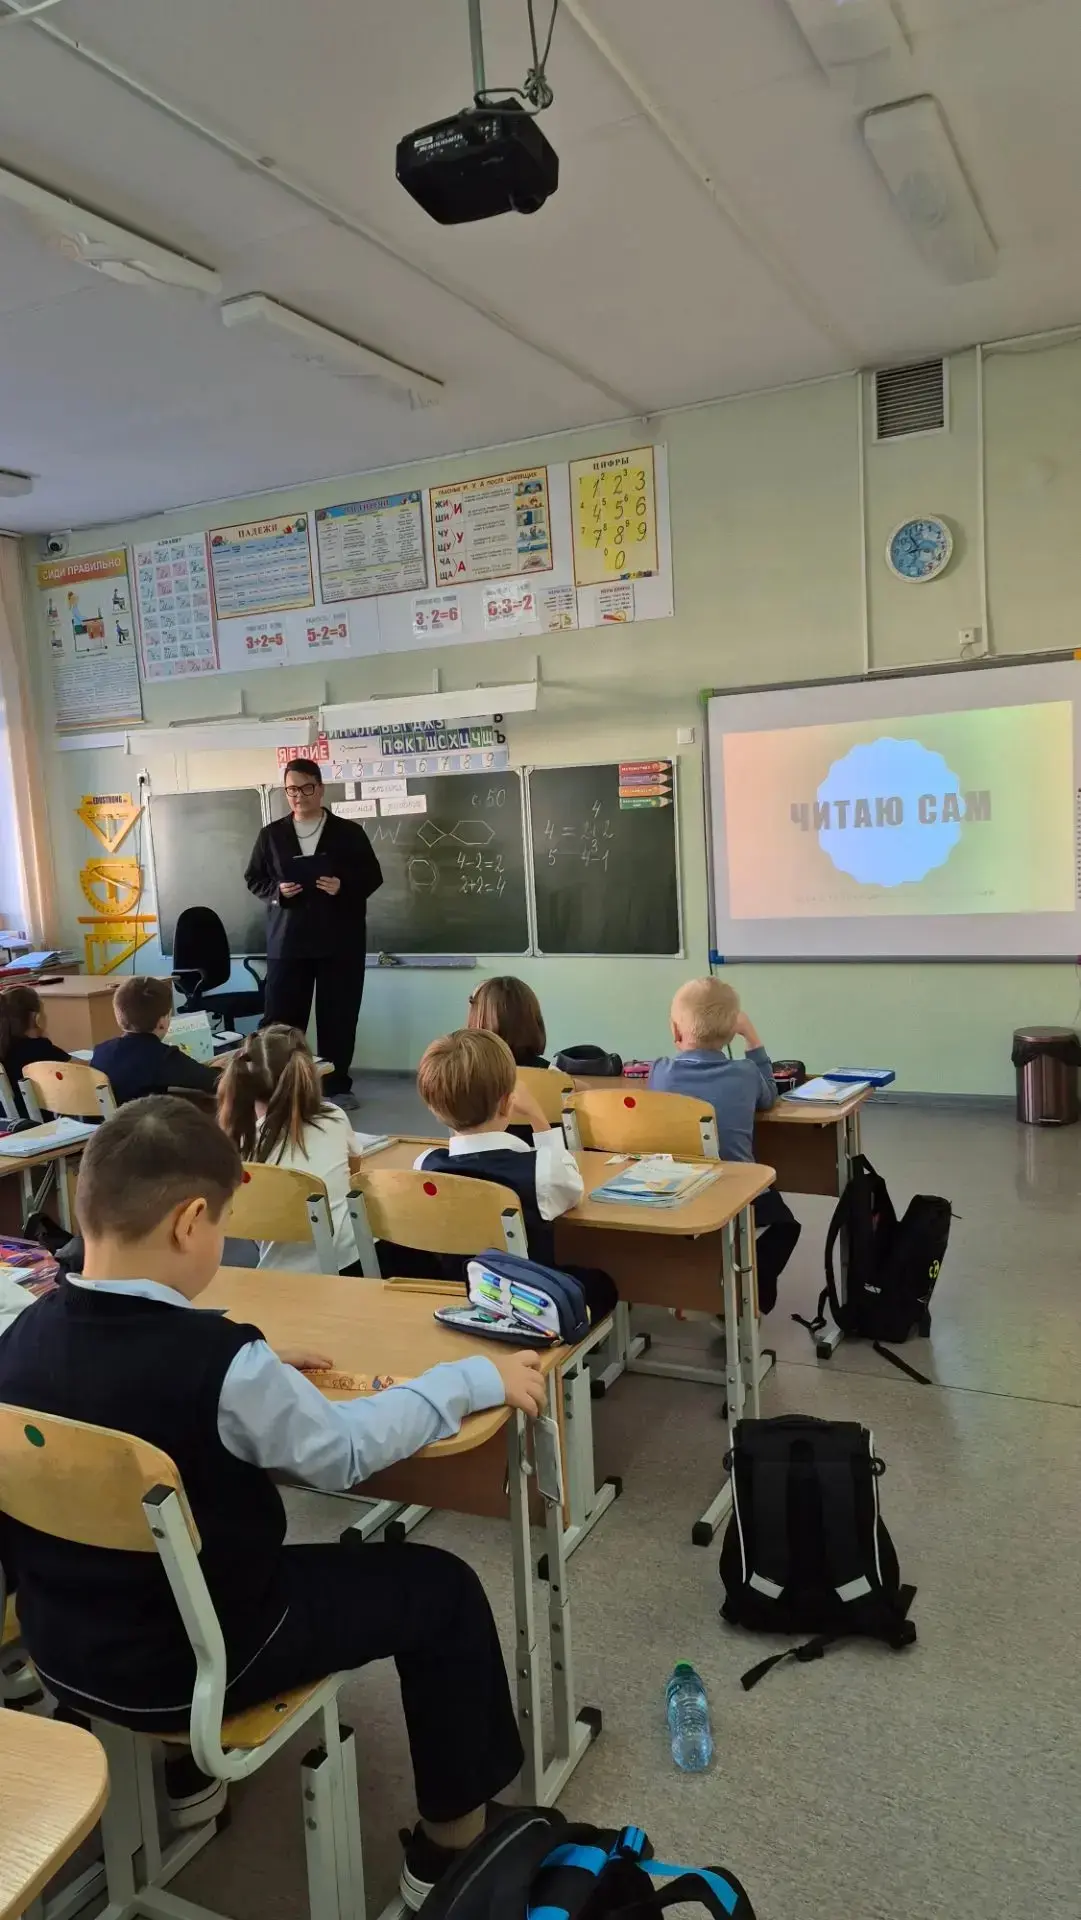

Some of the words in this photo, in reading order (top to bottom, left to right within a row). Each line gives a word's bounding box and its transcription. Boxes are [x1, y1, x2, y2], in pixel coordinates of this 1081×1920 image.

[593, 457, 629, 470] ЦИФРЫ
[592, 479, 600, 498] 1
[613, 475, 623, 494] 2
[635, 471, 646, 491] 3
[435, 499, 449, 508] ЖИ
[453, 503, 462, 515] И
[593, 503, 602, 522] 4
[614, 500, 624, 520] 5
[636, 496, 647, 516] 6
[435, 514, 450, 522] ШИ
[238, 524, 278, 538] ПАДЕЖИ
[438, 529, 449, 537] ЧУ
[456, 532, 464, 543] У
[593, 529, 602, 548] 7
[614, 526, 625, 545] 8
[636, 522, 647, 541] 9
[440, 558, 451, 566] ЧА
[458, 561, 466, 572] А
[614, 550, 625, 570] 0
[43, 568, 67, 580] СИДИ
[67, 558, 121, 576] ПРАВИЛЬНО
[246, 633, 283, 649] 3+2=5
[307, 624, 347, 641] 5-2=3
[335, 765, 342, 780] 2
[355, 763, 364, 777] 3
[377, 762, 384, 776] 4
[396, 760, 405, 775] 5
[419, 758, 427, 772] 6
[463, 754, 471, 769] 8
[485, 752, 494, 767] 9
[487, 788, 505, 807] 50
[592, 799, 601, 818] 4
[790, 796, 904, 831] ЧИТАЮ
[919, 790, 992, 823] САМ
[544, 820, 554, 839] 4
[548, 849, 558, 866] 5
